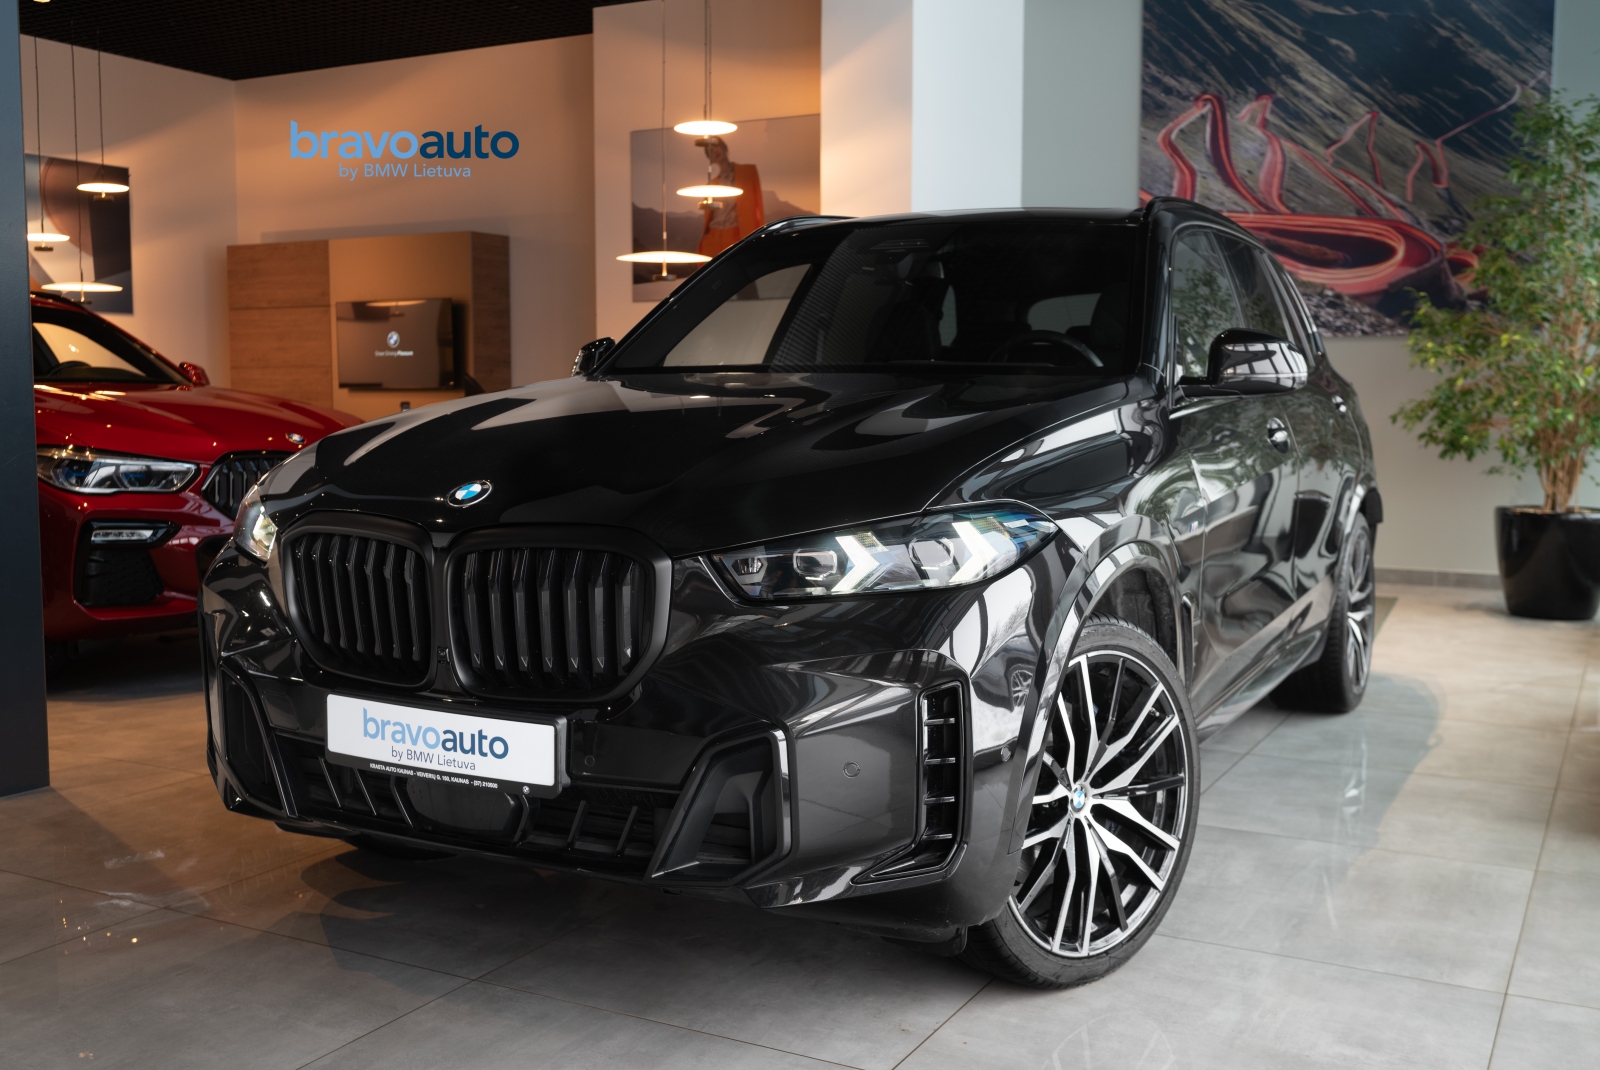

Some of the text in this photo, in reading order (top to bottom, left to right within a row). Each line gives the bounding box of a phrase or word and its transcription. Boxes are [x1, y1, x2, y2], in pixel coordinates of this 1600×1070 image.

[290, 120, 520, 159] bravoauto
[339, 163, 471, 181] by BMW Lietuva
[362, 707, 509, 759] bravoauto
[391, 746, 476, 771] by BMW Lietuva
